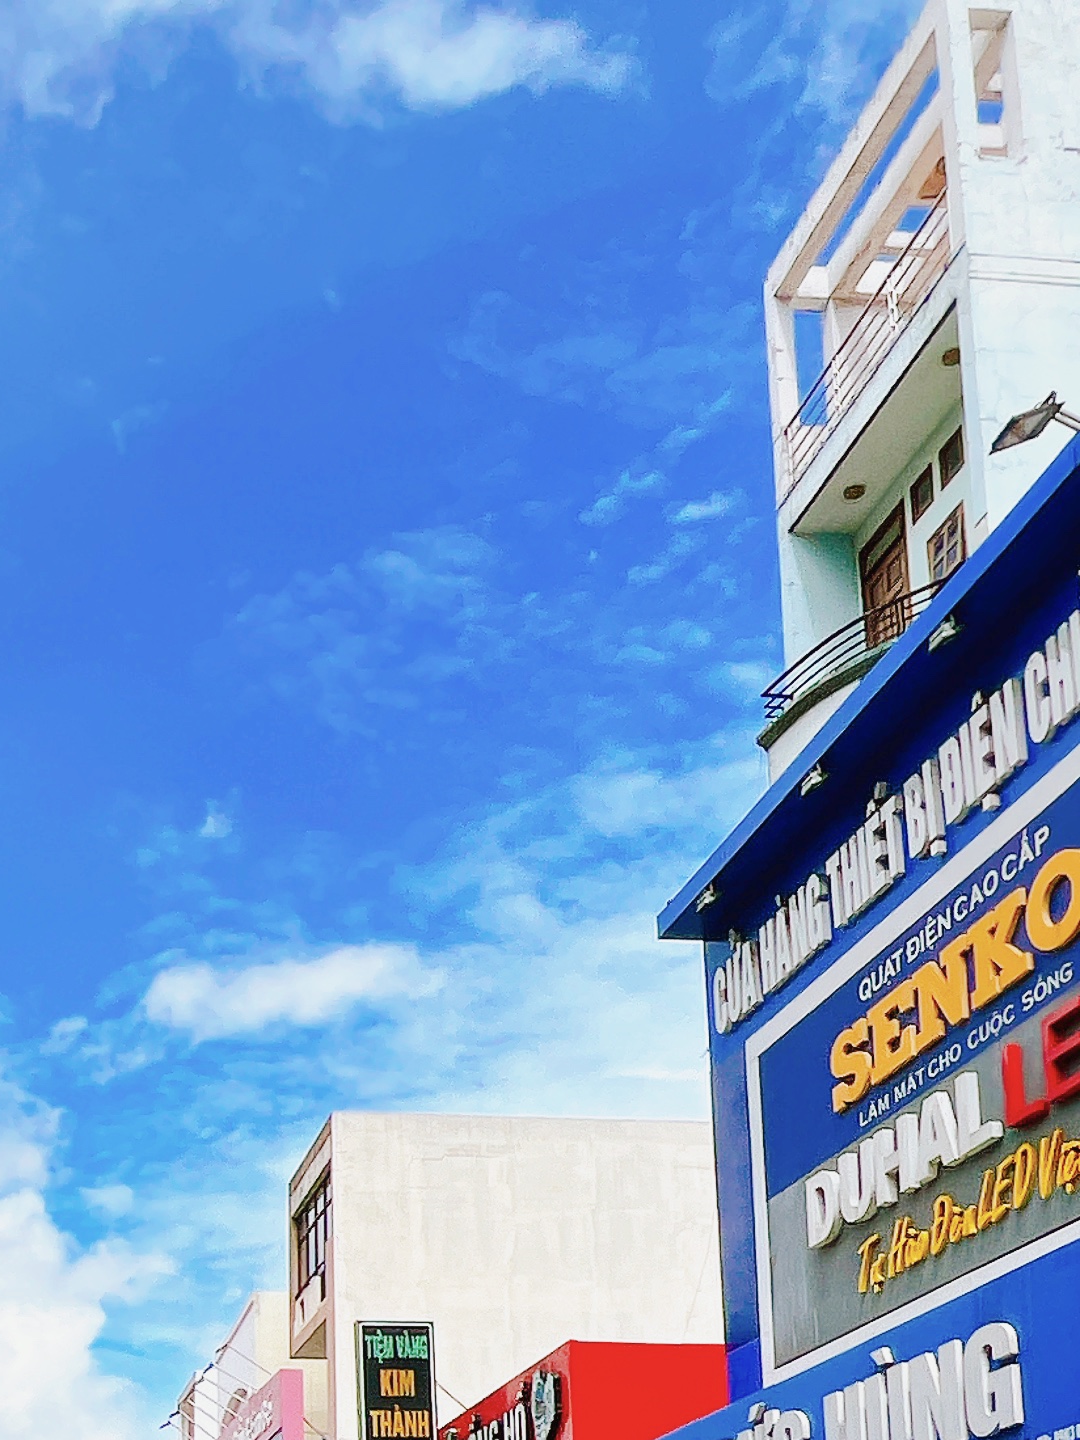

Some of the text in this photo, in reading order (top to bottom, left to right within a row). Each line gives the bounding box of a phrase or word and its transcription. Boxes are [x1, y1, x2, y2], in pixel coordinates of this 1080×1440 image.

[713, 929, 764, 1035] CỬA
[758, 872, 833, 995] HÀNG
[825, 782, 906, 929] THIẾT
[902, 758, 948, 860] BỊ
[938, 680, 1028, 825] ĐIỆN
[858, 825, 1051, 1002] QUẠT ĐIỆN CAO CẤP
[830, 847, 1080, 1114] SENKO
[859, 1096, 891, 1128] LÀM
[926, 1044, 962, 1079] CHO
[966, 1005, 1015, 1050] CUỘC
[1021, 962, 1075, 1012] SỐNG
[805, 1070, 1005, 1249] DUHAL
[976, 1141, 1038, 1231] LED
[370, 1404, 430, 1438] THÀNH
[379, 1369, 415, 1397] KIM
[396, 1330, 428, 1359] VÀNG
